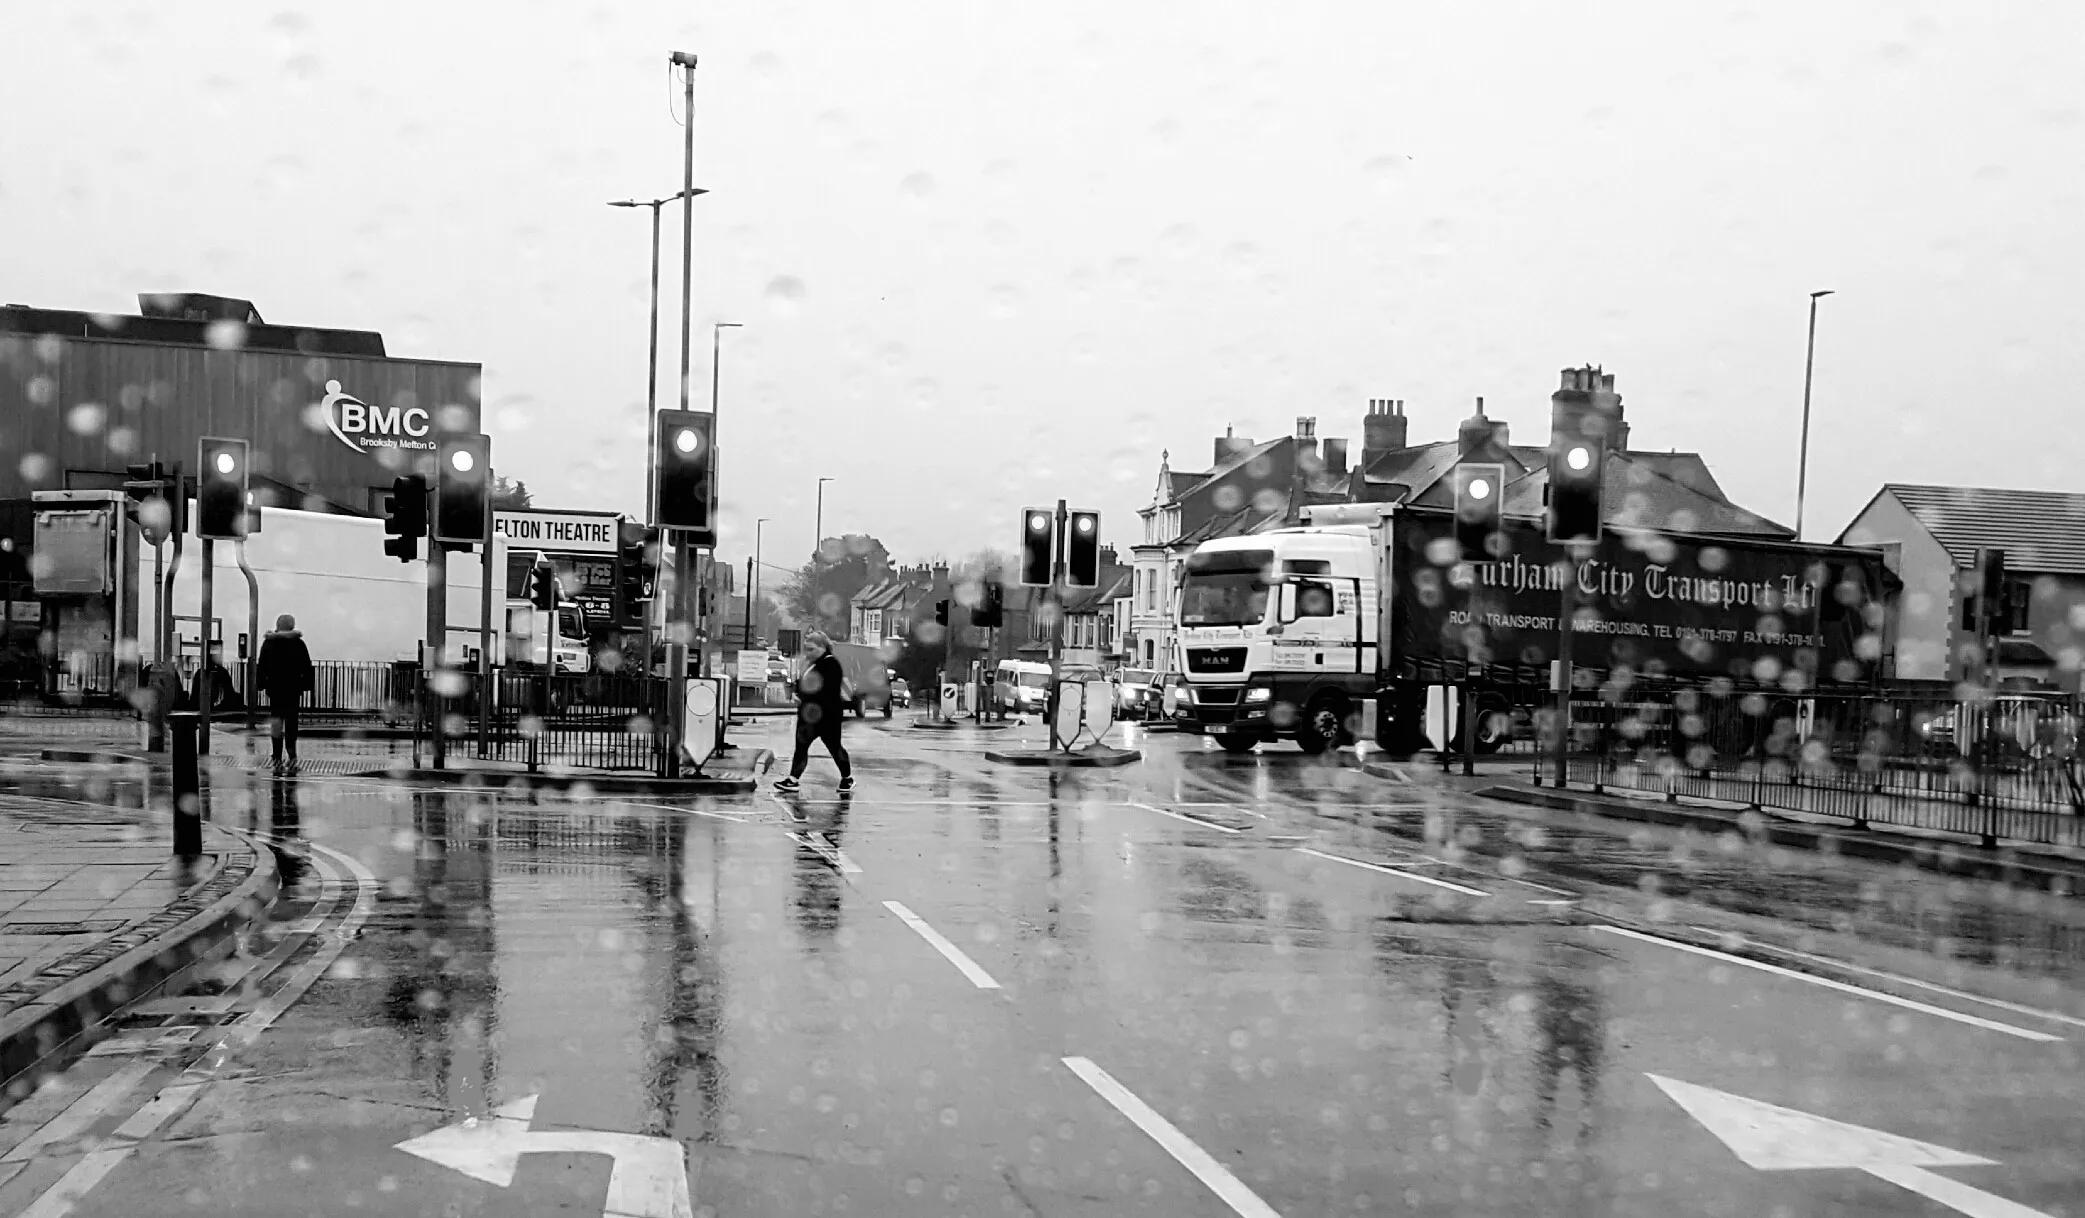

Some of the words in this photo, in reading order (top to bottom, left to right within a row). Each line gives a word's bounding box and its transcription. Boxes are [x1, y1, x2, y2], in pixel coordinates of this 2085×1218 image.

[342, 404, 429, 437] BMC
[360, 437, 398, 449] Brooksby
[399, 439, 427, 449] Melton
[545, 521, 610, 543] THEATRE
[1577, 558, 1634, 603] City
[1644, 563, 1772, 611] Transport
[1486, 612, 1556, 631] TRANSPORT
[1653, 624, 1673, 638] TEL
[1743, 631, 1762, 644] FAX
[1202, 656, 1229, 664] MAN
